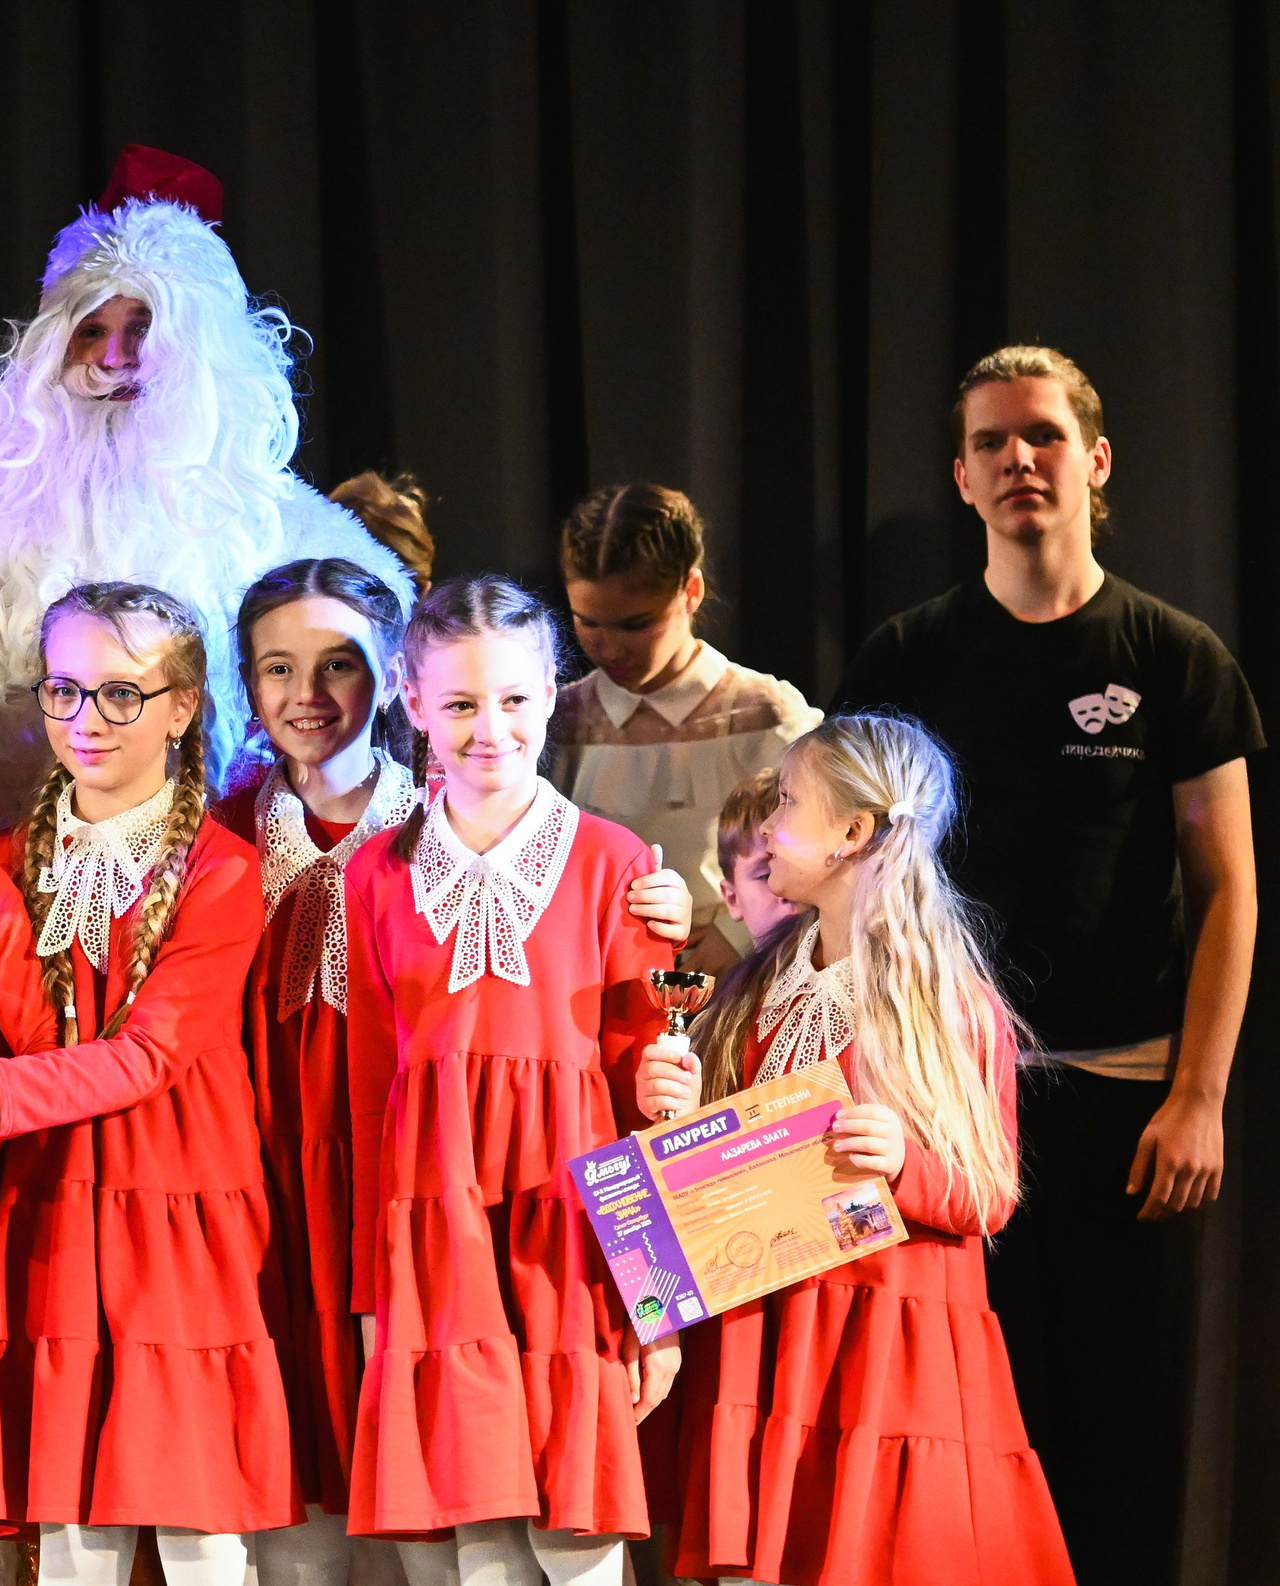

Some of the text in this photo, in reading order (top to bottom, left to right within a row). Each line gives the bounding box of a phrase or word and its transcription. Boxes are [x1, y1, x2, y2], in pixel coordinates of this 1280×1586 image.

[662, 1116, 728, 1155] ЛАУРЕАТ
[765, 1089, 811, 1113] СТЕПЕНИ
[721, 1128, 790, 1162] ЛАЗАРЕВА ЗЛАТА
